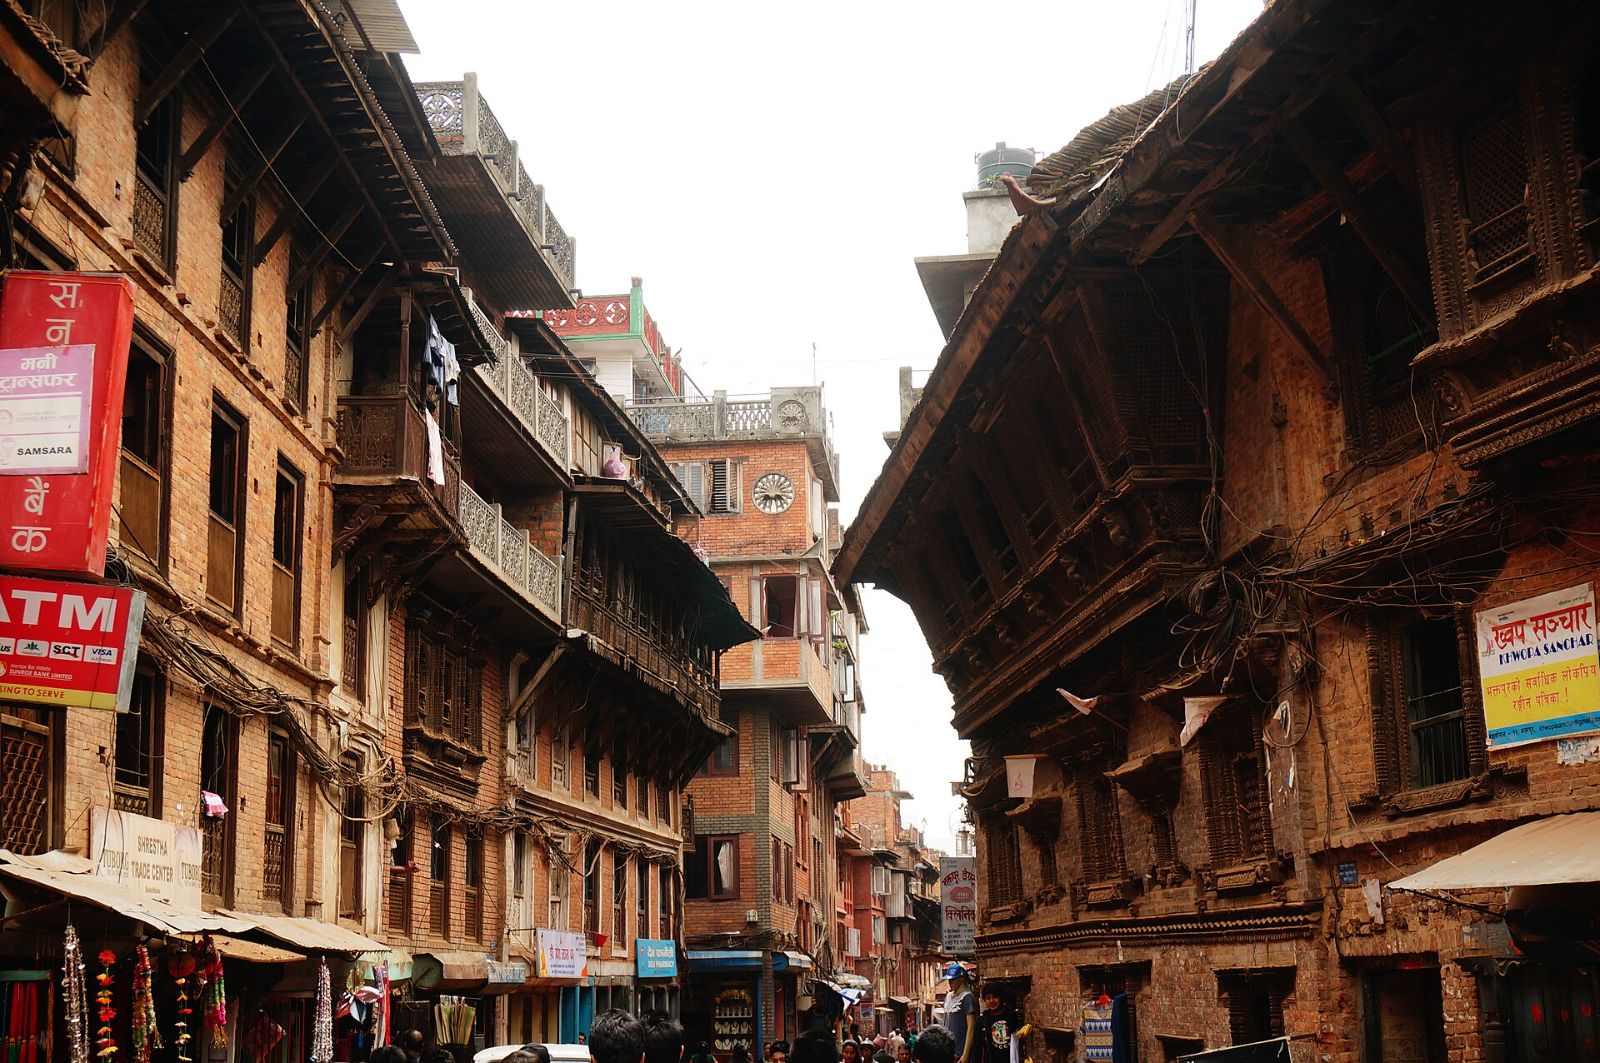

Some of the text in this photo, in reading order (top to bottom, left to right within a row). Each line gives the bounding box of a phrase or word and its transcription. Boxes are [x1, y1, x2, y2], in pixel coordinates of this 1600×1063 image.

[20, 353, 58, 370] मनी
[17, 446, 72, 456] SAMSARA
[0, 589, 117, 633] TM
[1491, 602, 1592, 650] ख्वप सञ्चार
[53, 644, 80, 656] SCT
[92, 648, 112, 656] VISA
[1499, 633, 1594, 665] KHWOPA SANCHAR
[9, 668, 32, 676] SUNRISE
[1525, 671, 1557, 689] सर्वाधिक
[23, 687, 35, 696] TO
[36, 689, 65, 699] SERVE
[137, 835, 168, 856] SHRESTHA
[131, 860, 150, 880] TRADE
[152, 862, 173, 883] CENTER
